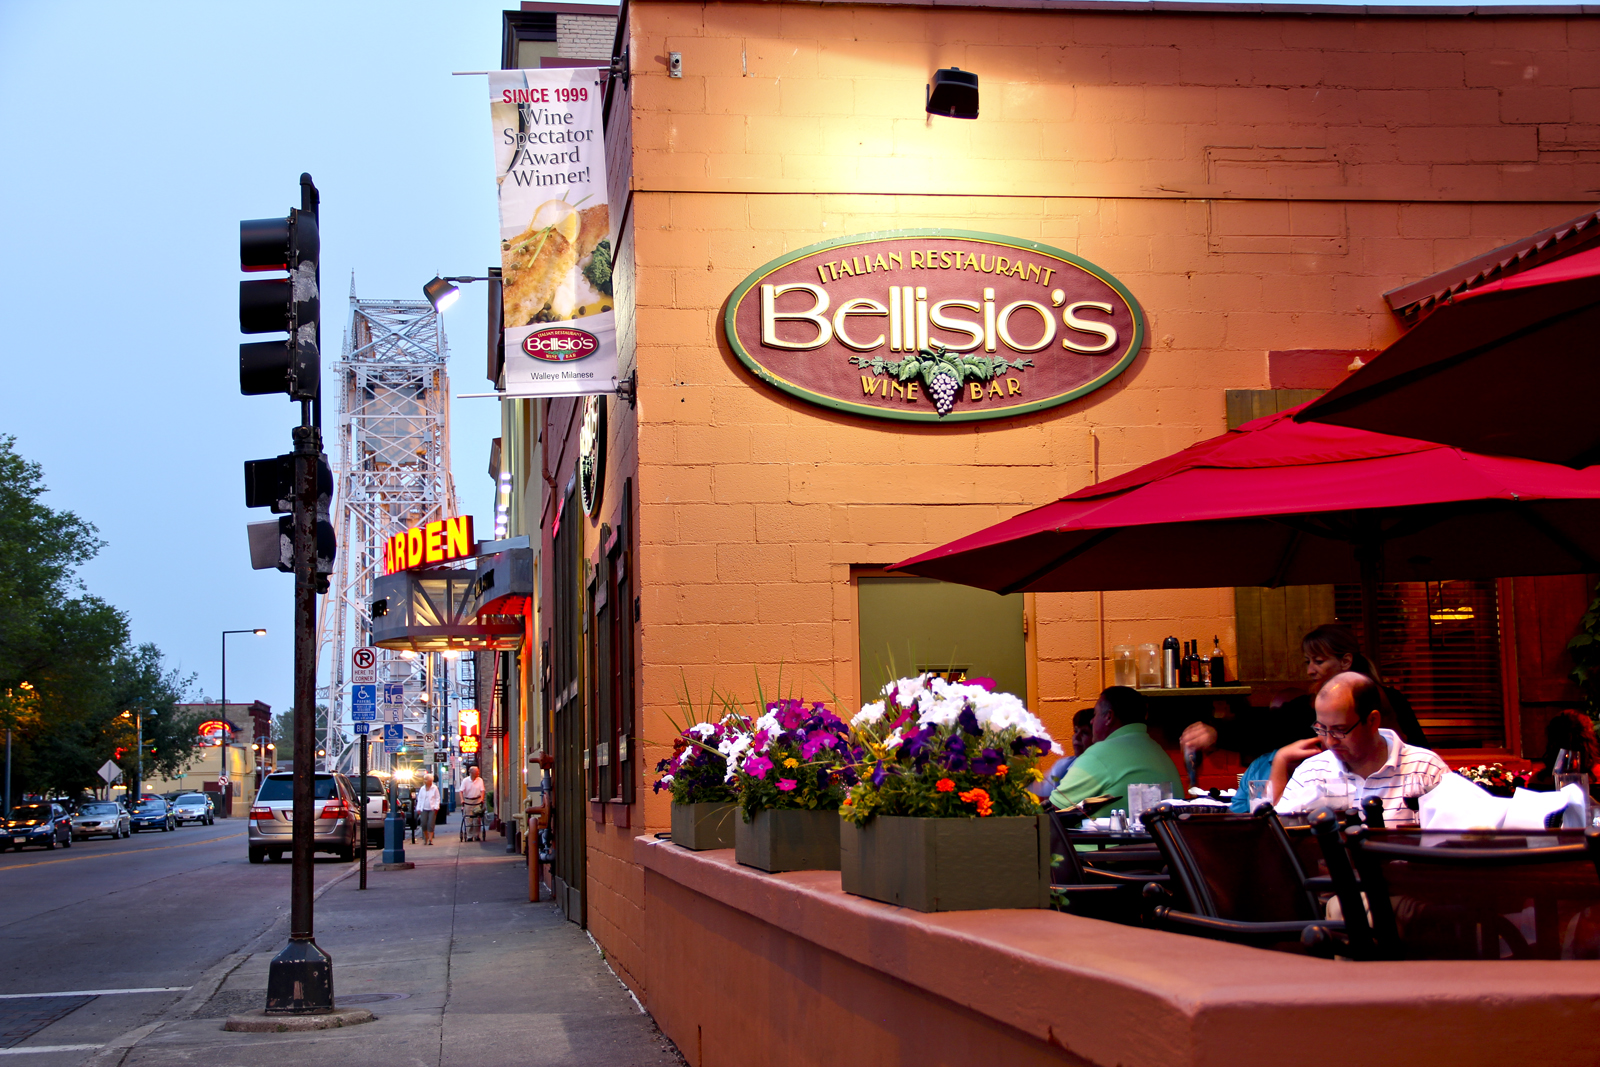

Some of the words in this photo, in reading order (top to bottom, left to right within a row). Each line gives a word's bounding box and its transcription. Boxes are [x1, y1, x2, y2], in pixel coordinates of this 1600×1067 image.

[502, 88, 550, 104] SINCE
[554, 87, 588, 102] 1999
[519, 108, 574, 126] Wine
[503, 127, 594, 151] Spectator
[519, 145, 581, 166] Award
[512, 166, 591, 187] Winner!
[816, 250, 904, 284] ITALIAN
[910, 249, 1057, 287] RESTAURANT
[760, 282, 1119, 353] Bellisio's
[527, 337, 594, 351] Bellisio's
[530, 372, 560, 381] Walleye
[561, 371, 594, 379] Milanese
[861, 375, 918, 400] WINE
[970, 376, 1022, 400] BAR
[384, 514, 470, 576] ARDEN
